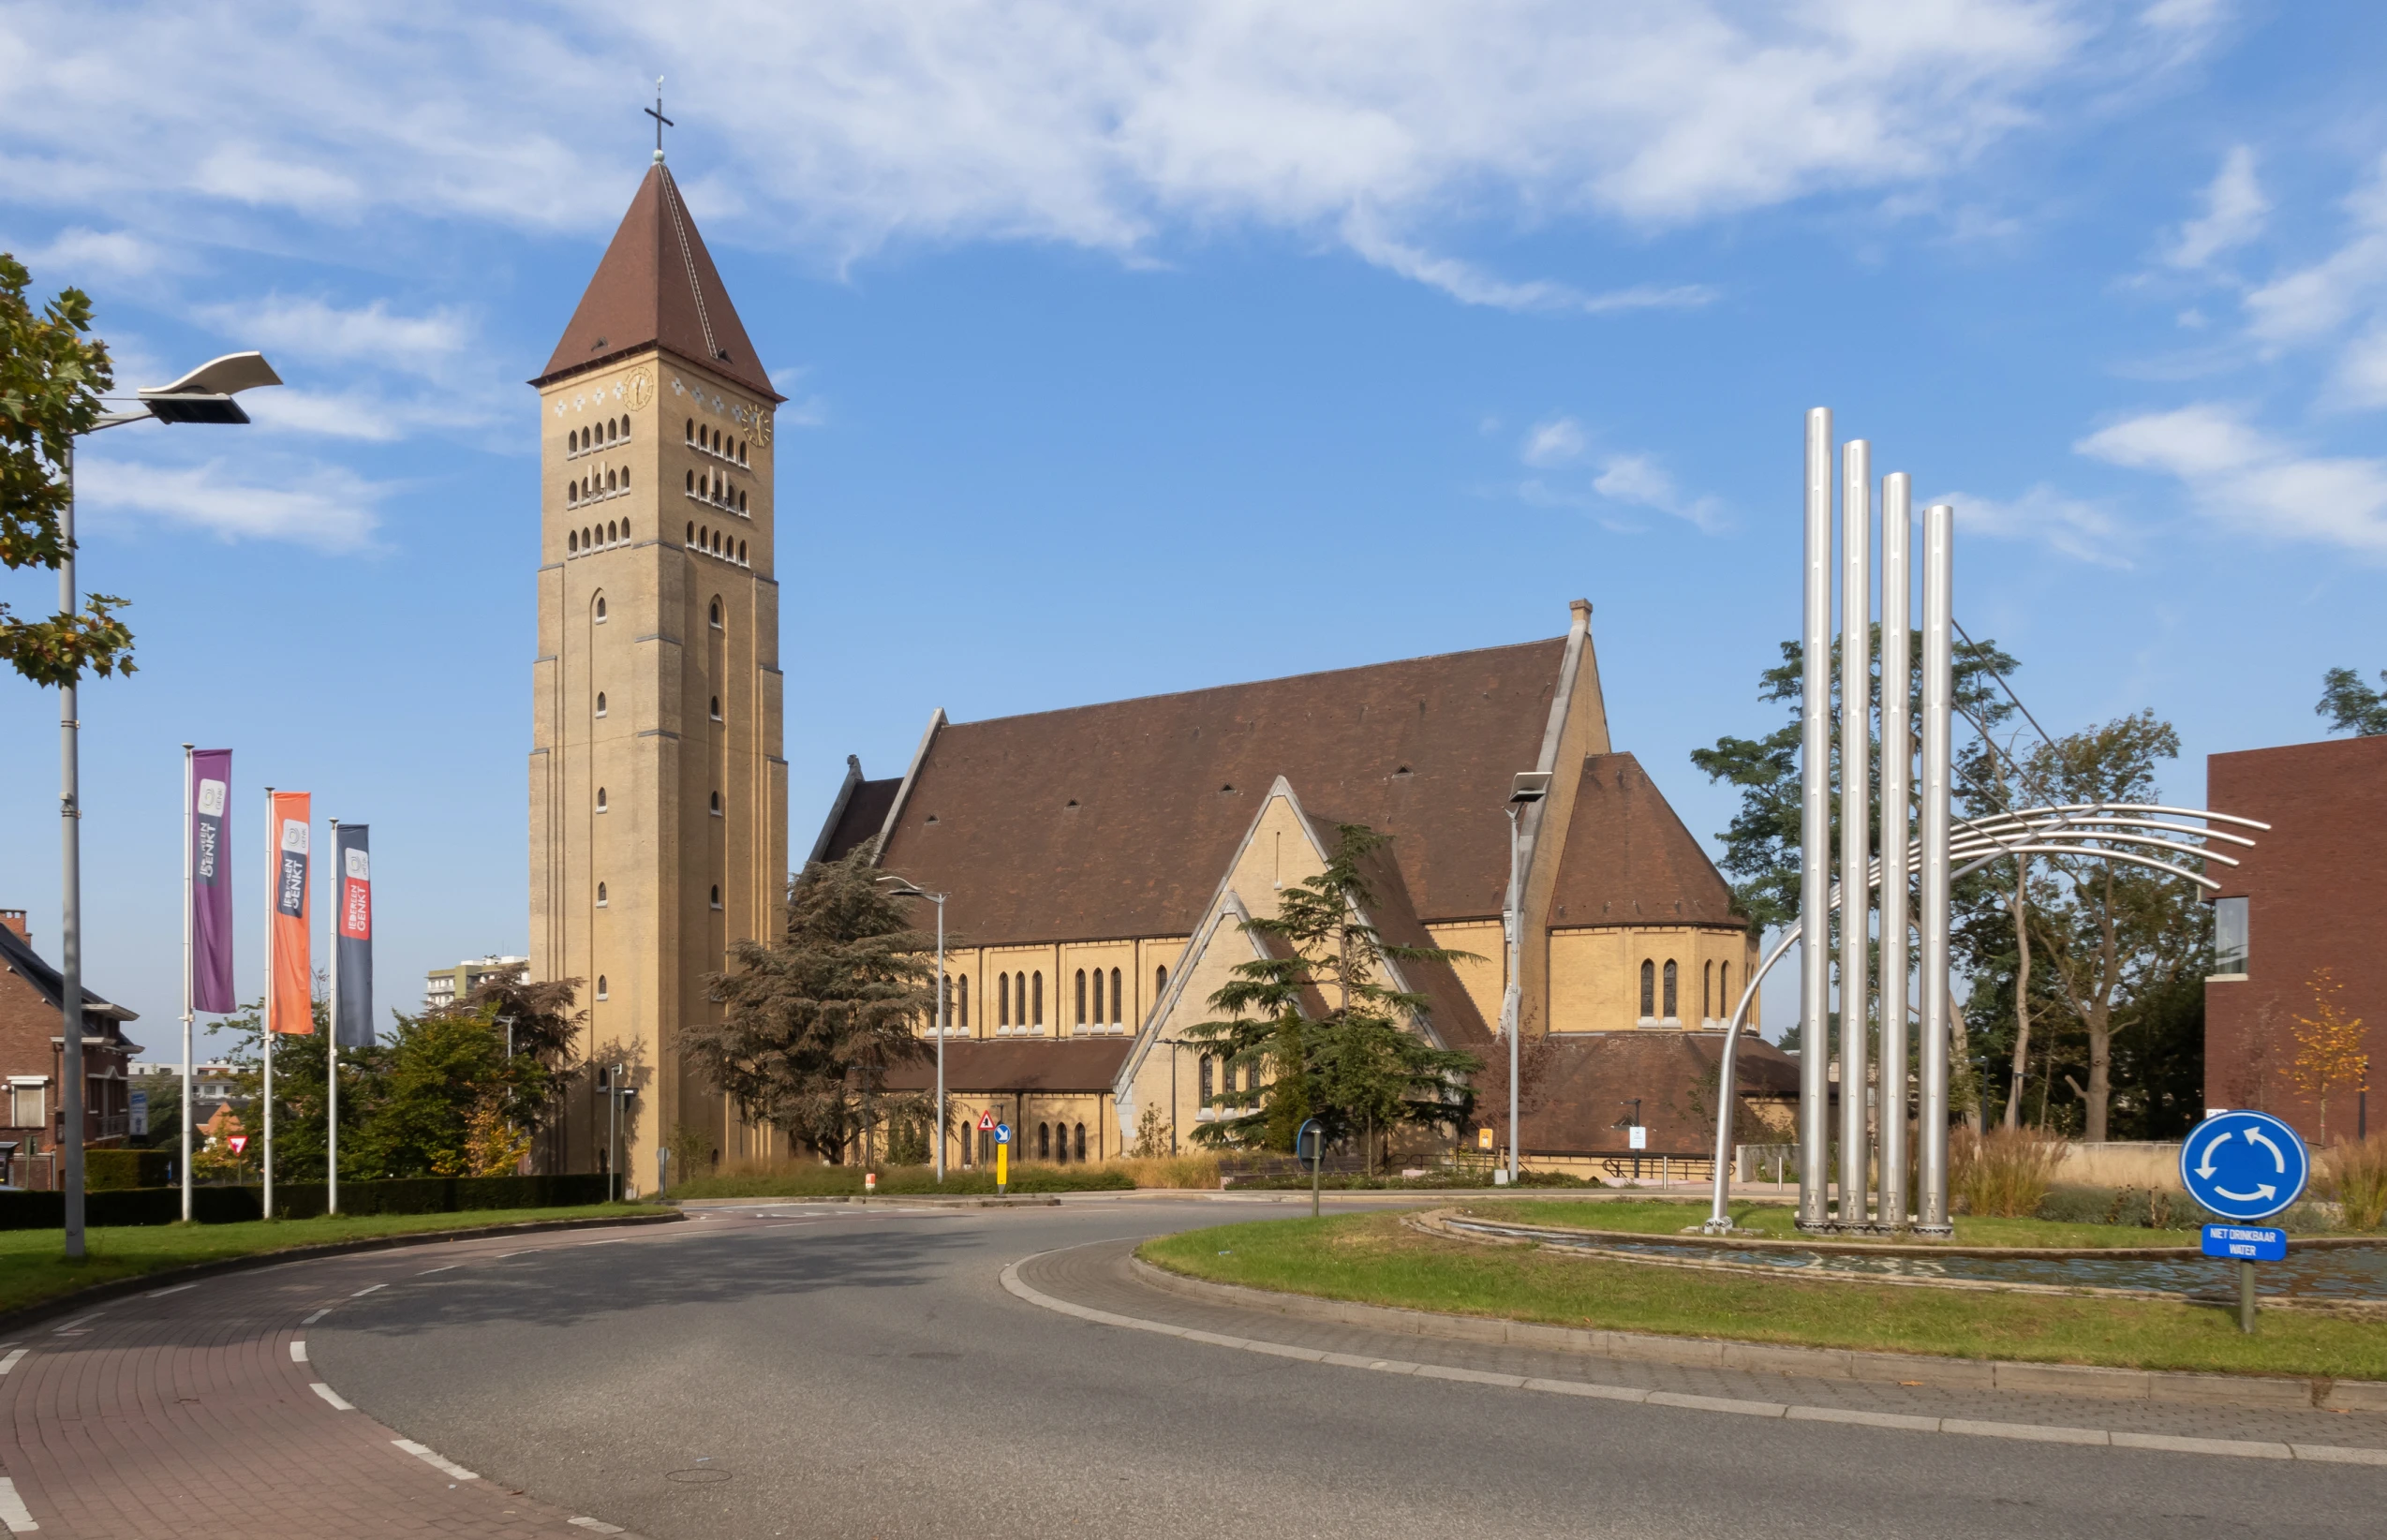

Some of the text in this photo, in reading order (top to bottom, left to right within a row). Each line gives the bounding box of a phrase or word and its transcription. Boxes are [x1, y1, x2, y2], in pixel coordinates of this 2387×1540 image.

[348, 885, 357, 929] IEDEREEN
[357, 886, 366, 931] GENKT
[2210, 1228, 2276, 1242] NIET DRINKBAAR
[2230, 1244, 2256, 1255] WATER
